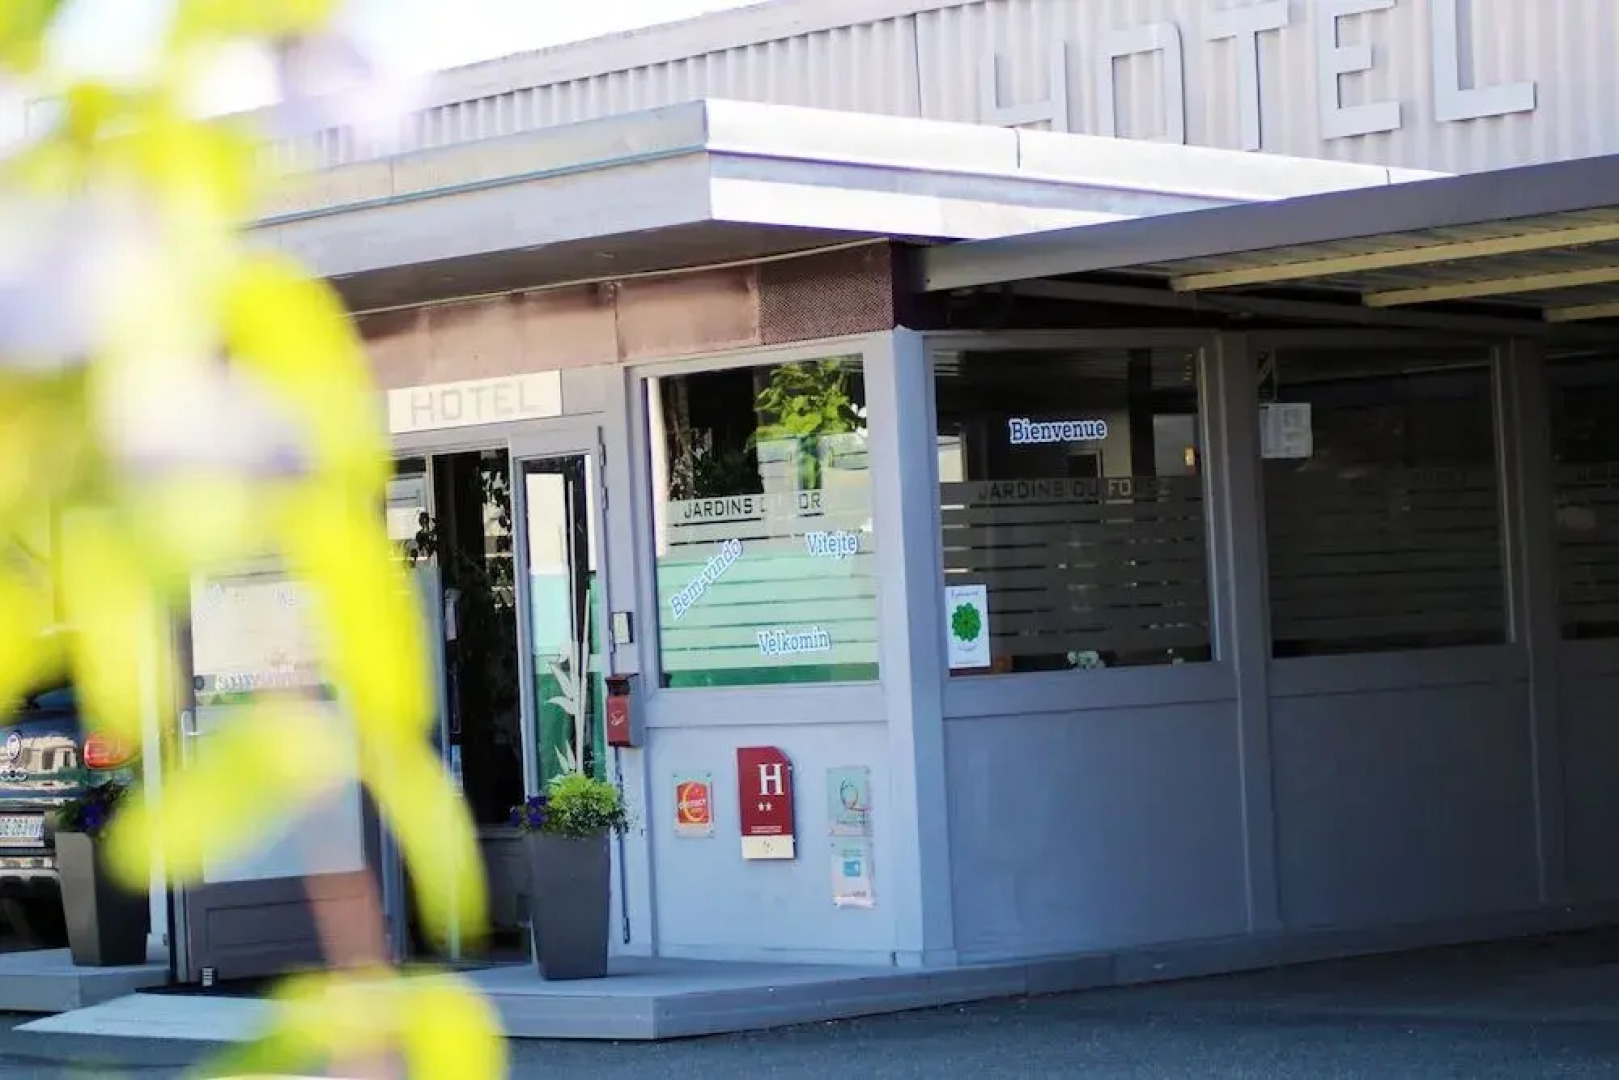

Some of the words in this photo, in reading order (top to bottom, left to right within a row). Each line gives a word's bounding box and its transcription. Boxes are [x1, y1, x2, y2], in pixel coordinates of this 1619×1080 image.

[978, 0, 1537, 152] HOTEL
[411, 380, 544, 425] HOTEL
[1009, 418, 1106, 442] Bienvenue
[685, 497, 752, 518] JARDINS
[670, 539, 743, 618] Bem-vindo
[757, 763, 785, 795] H
